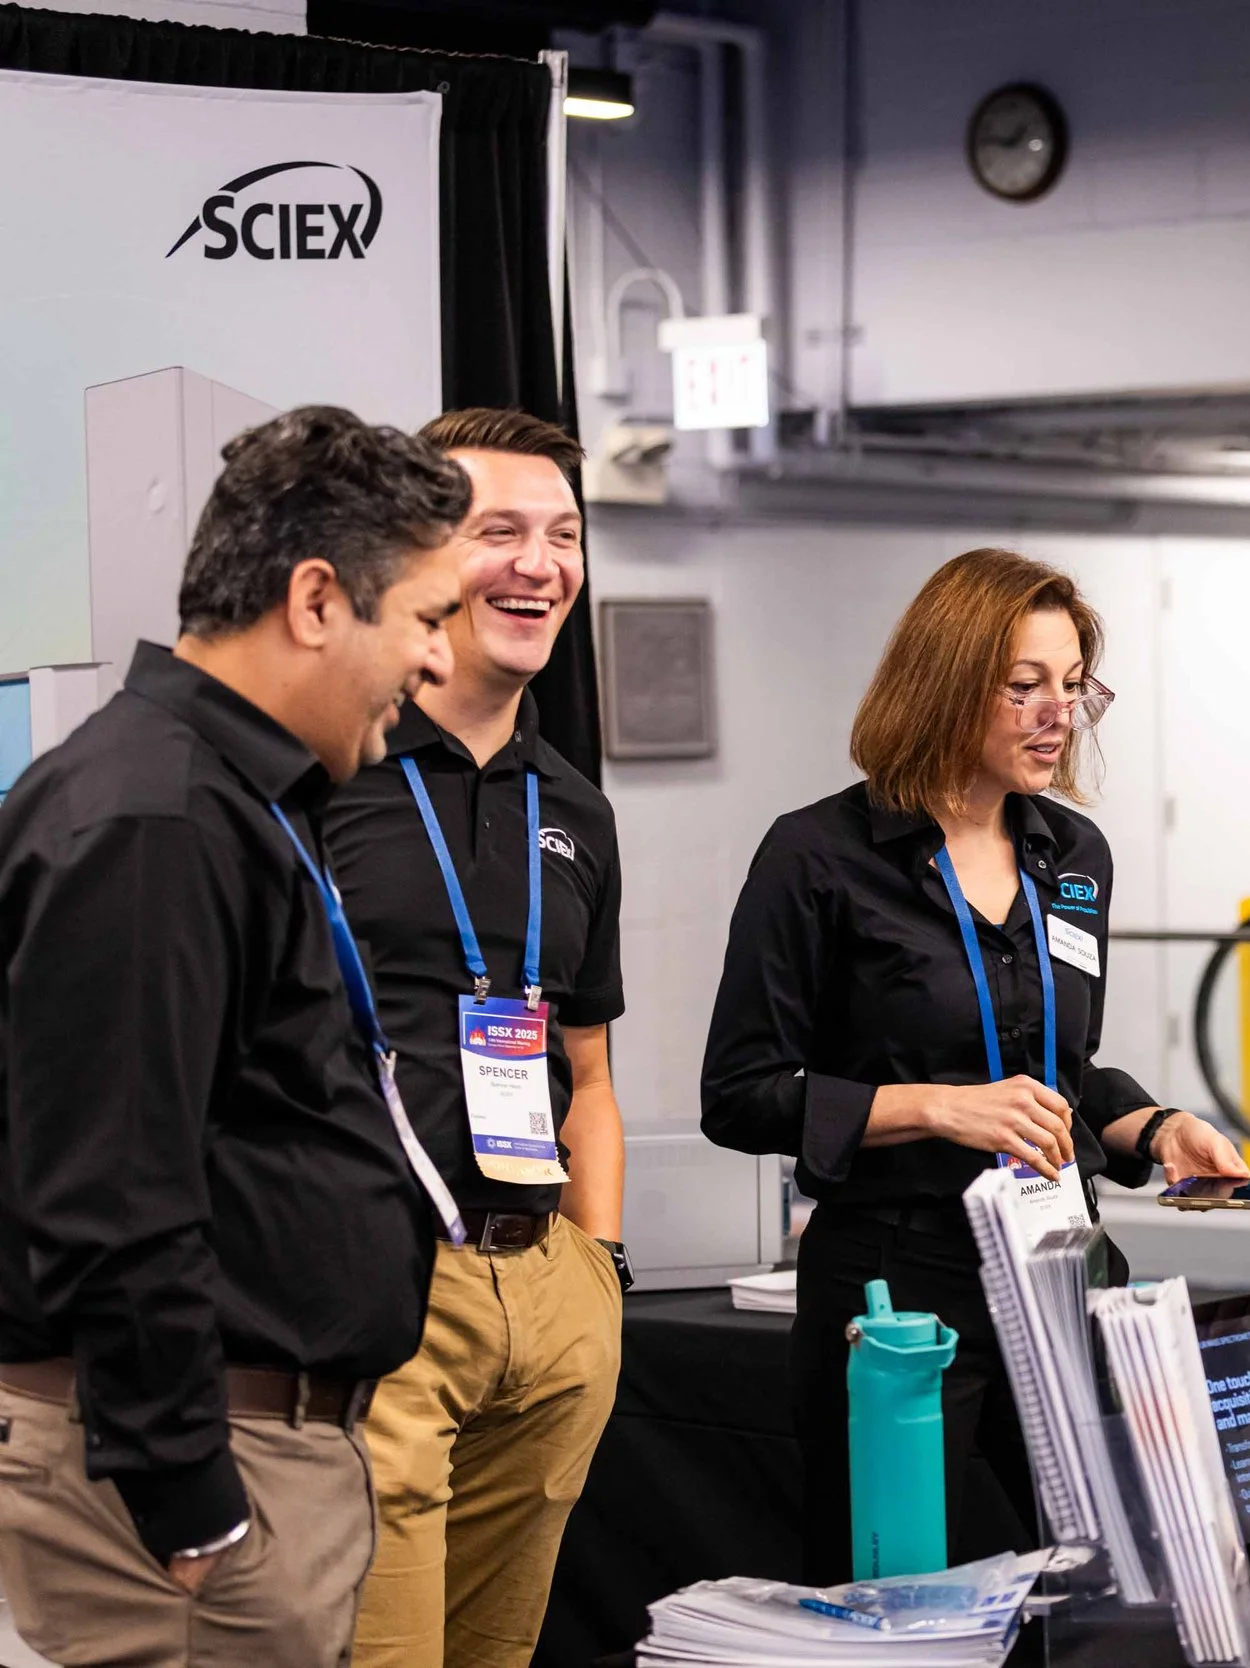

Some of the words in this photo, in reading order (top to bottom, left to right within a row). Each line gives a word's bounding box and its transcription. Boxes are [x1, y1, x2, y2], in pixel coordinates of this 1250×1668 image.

[202, 194, 365, 260] SCIEX
[1051, 935, 1077, 952] AMANDA
[487, 1025, 513, 1038] ISSX
[514, 1029, 538, 1040] 2025
[478, 1065, 529, 1080] SPENCER
[1020, 1181, 1062, 1197] AMANDA
[1206, 1379, 1227, 1395] One
[1216, 1412, 1236, 1431] and
